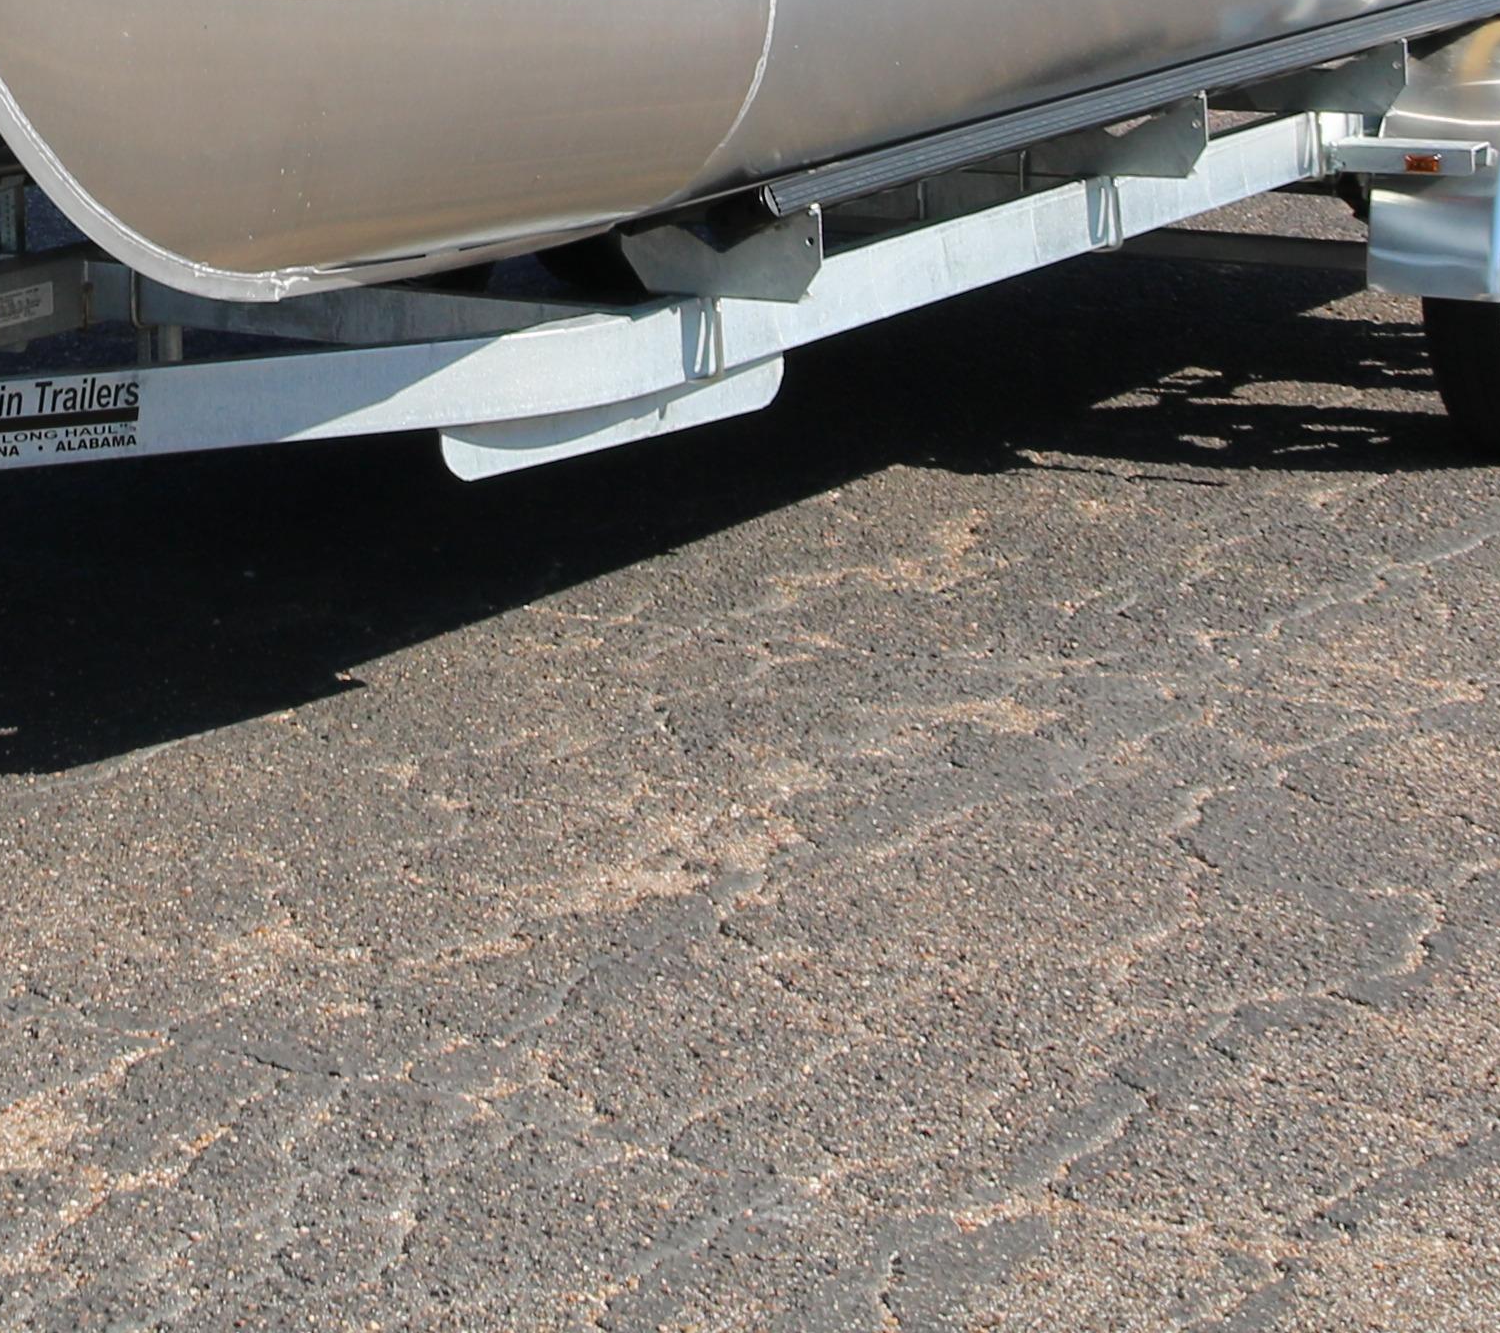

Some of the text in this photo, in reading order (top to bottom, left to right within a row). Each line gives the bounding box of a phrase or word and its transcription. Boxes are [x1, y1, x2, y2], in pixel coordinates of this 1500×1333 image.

[35, 377, 140, 413] Trailers
[1, 429, 58, 444] LONG
[55, 434, 137, 453] ALABAMA
